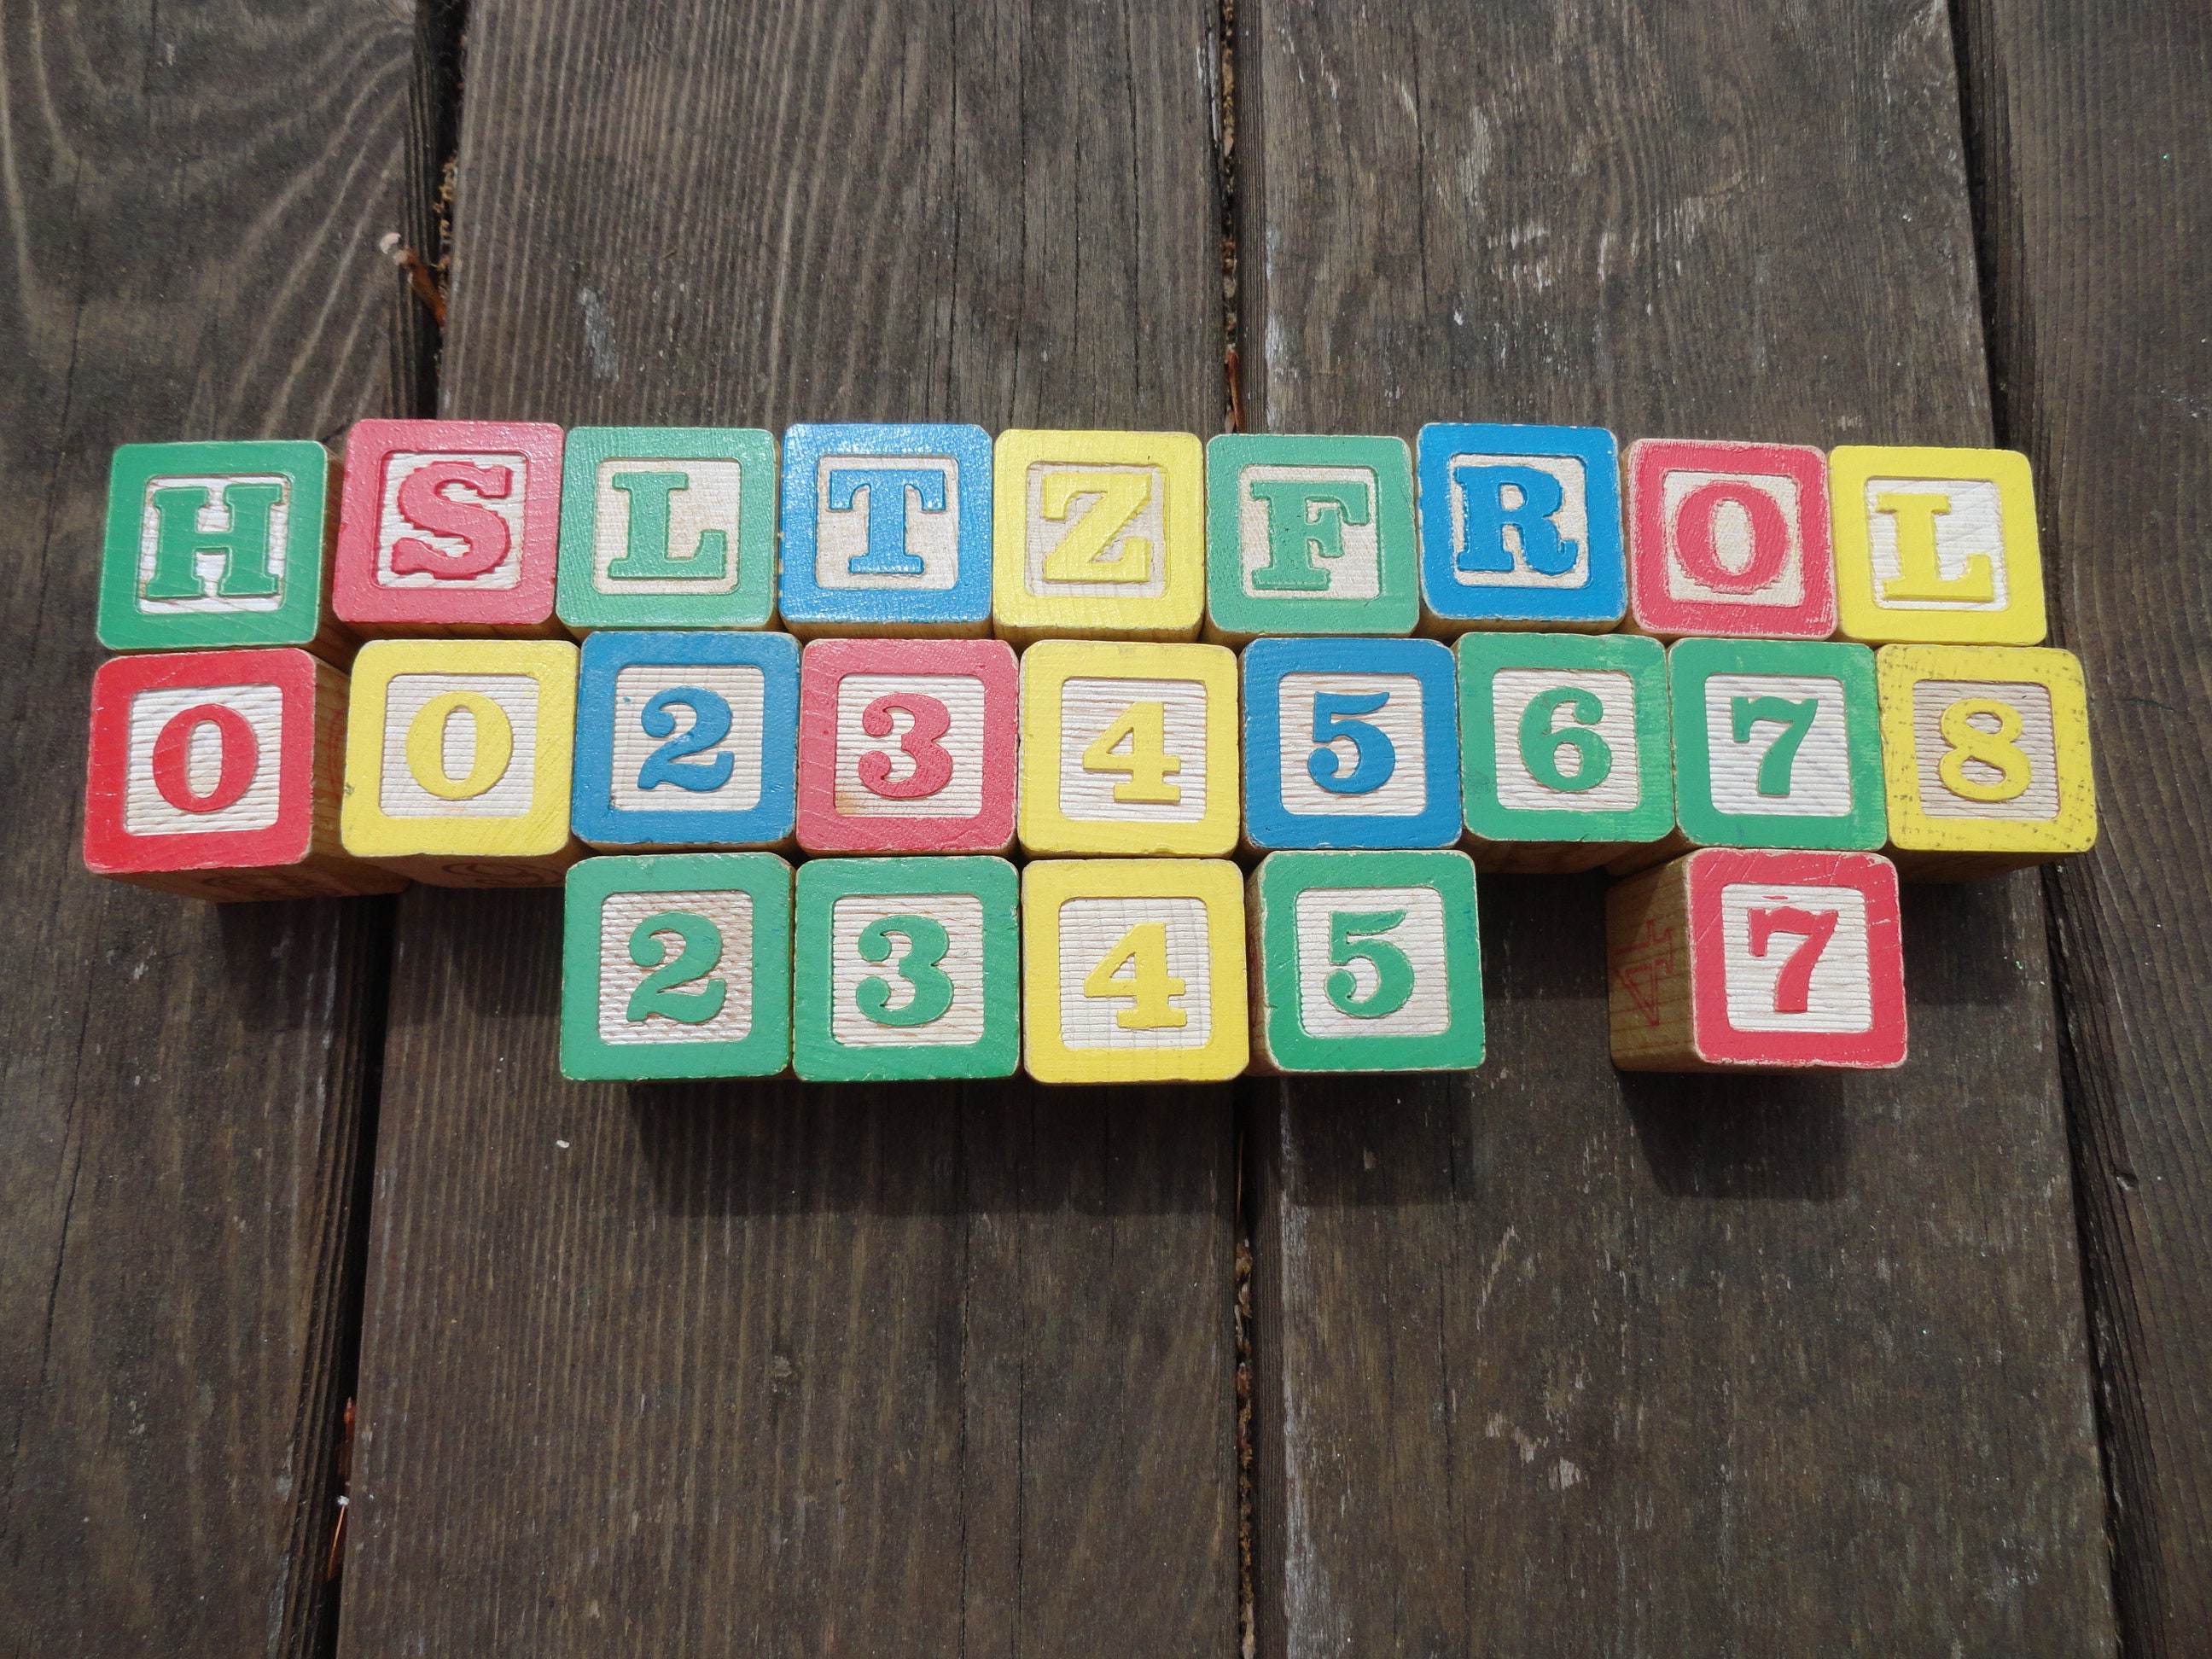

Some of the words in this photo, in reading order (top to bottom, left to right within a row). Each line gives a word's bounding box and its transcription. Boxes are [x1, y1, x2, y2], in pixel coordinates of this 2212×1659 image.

[145, 485, 282, 600] H
[390, 462, 512, 580] S
[608, 471, 727, 579] L
[829, 469, 946, 574] T
[1041, 472, 1153, 583] Z
[1250, 480, 1372, 591] F
[1454, 464, 1578, 577] R
[1673, 480, 1789, 594] O
[1877, 493, 1994, 602] L
[637, 685, 736, 792] 2
[857, 692, 953, 798] 3
[1082, 701, 1181, 803] 4
[1307, 691, 1396, 795] 5
[1519, 687, 1612, 794] 6
[1732, 696, 1817, 795] 7
[1939, 697, 2033, 801] 8
[626, 911, 725, 1024] 2
[856, 915, 954, 1027] 3
[1083, 922, 1187, 1029] 4
[1324, 911, 1415, 1019] 5
[1748, 905, 1838, 1013] 7
